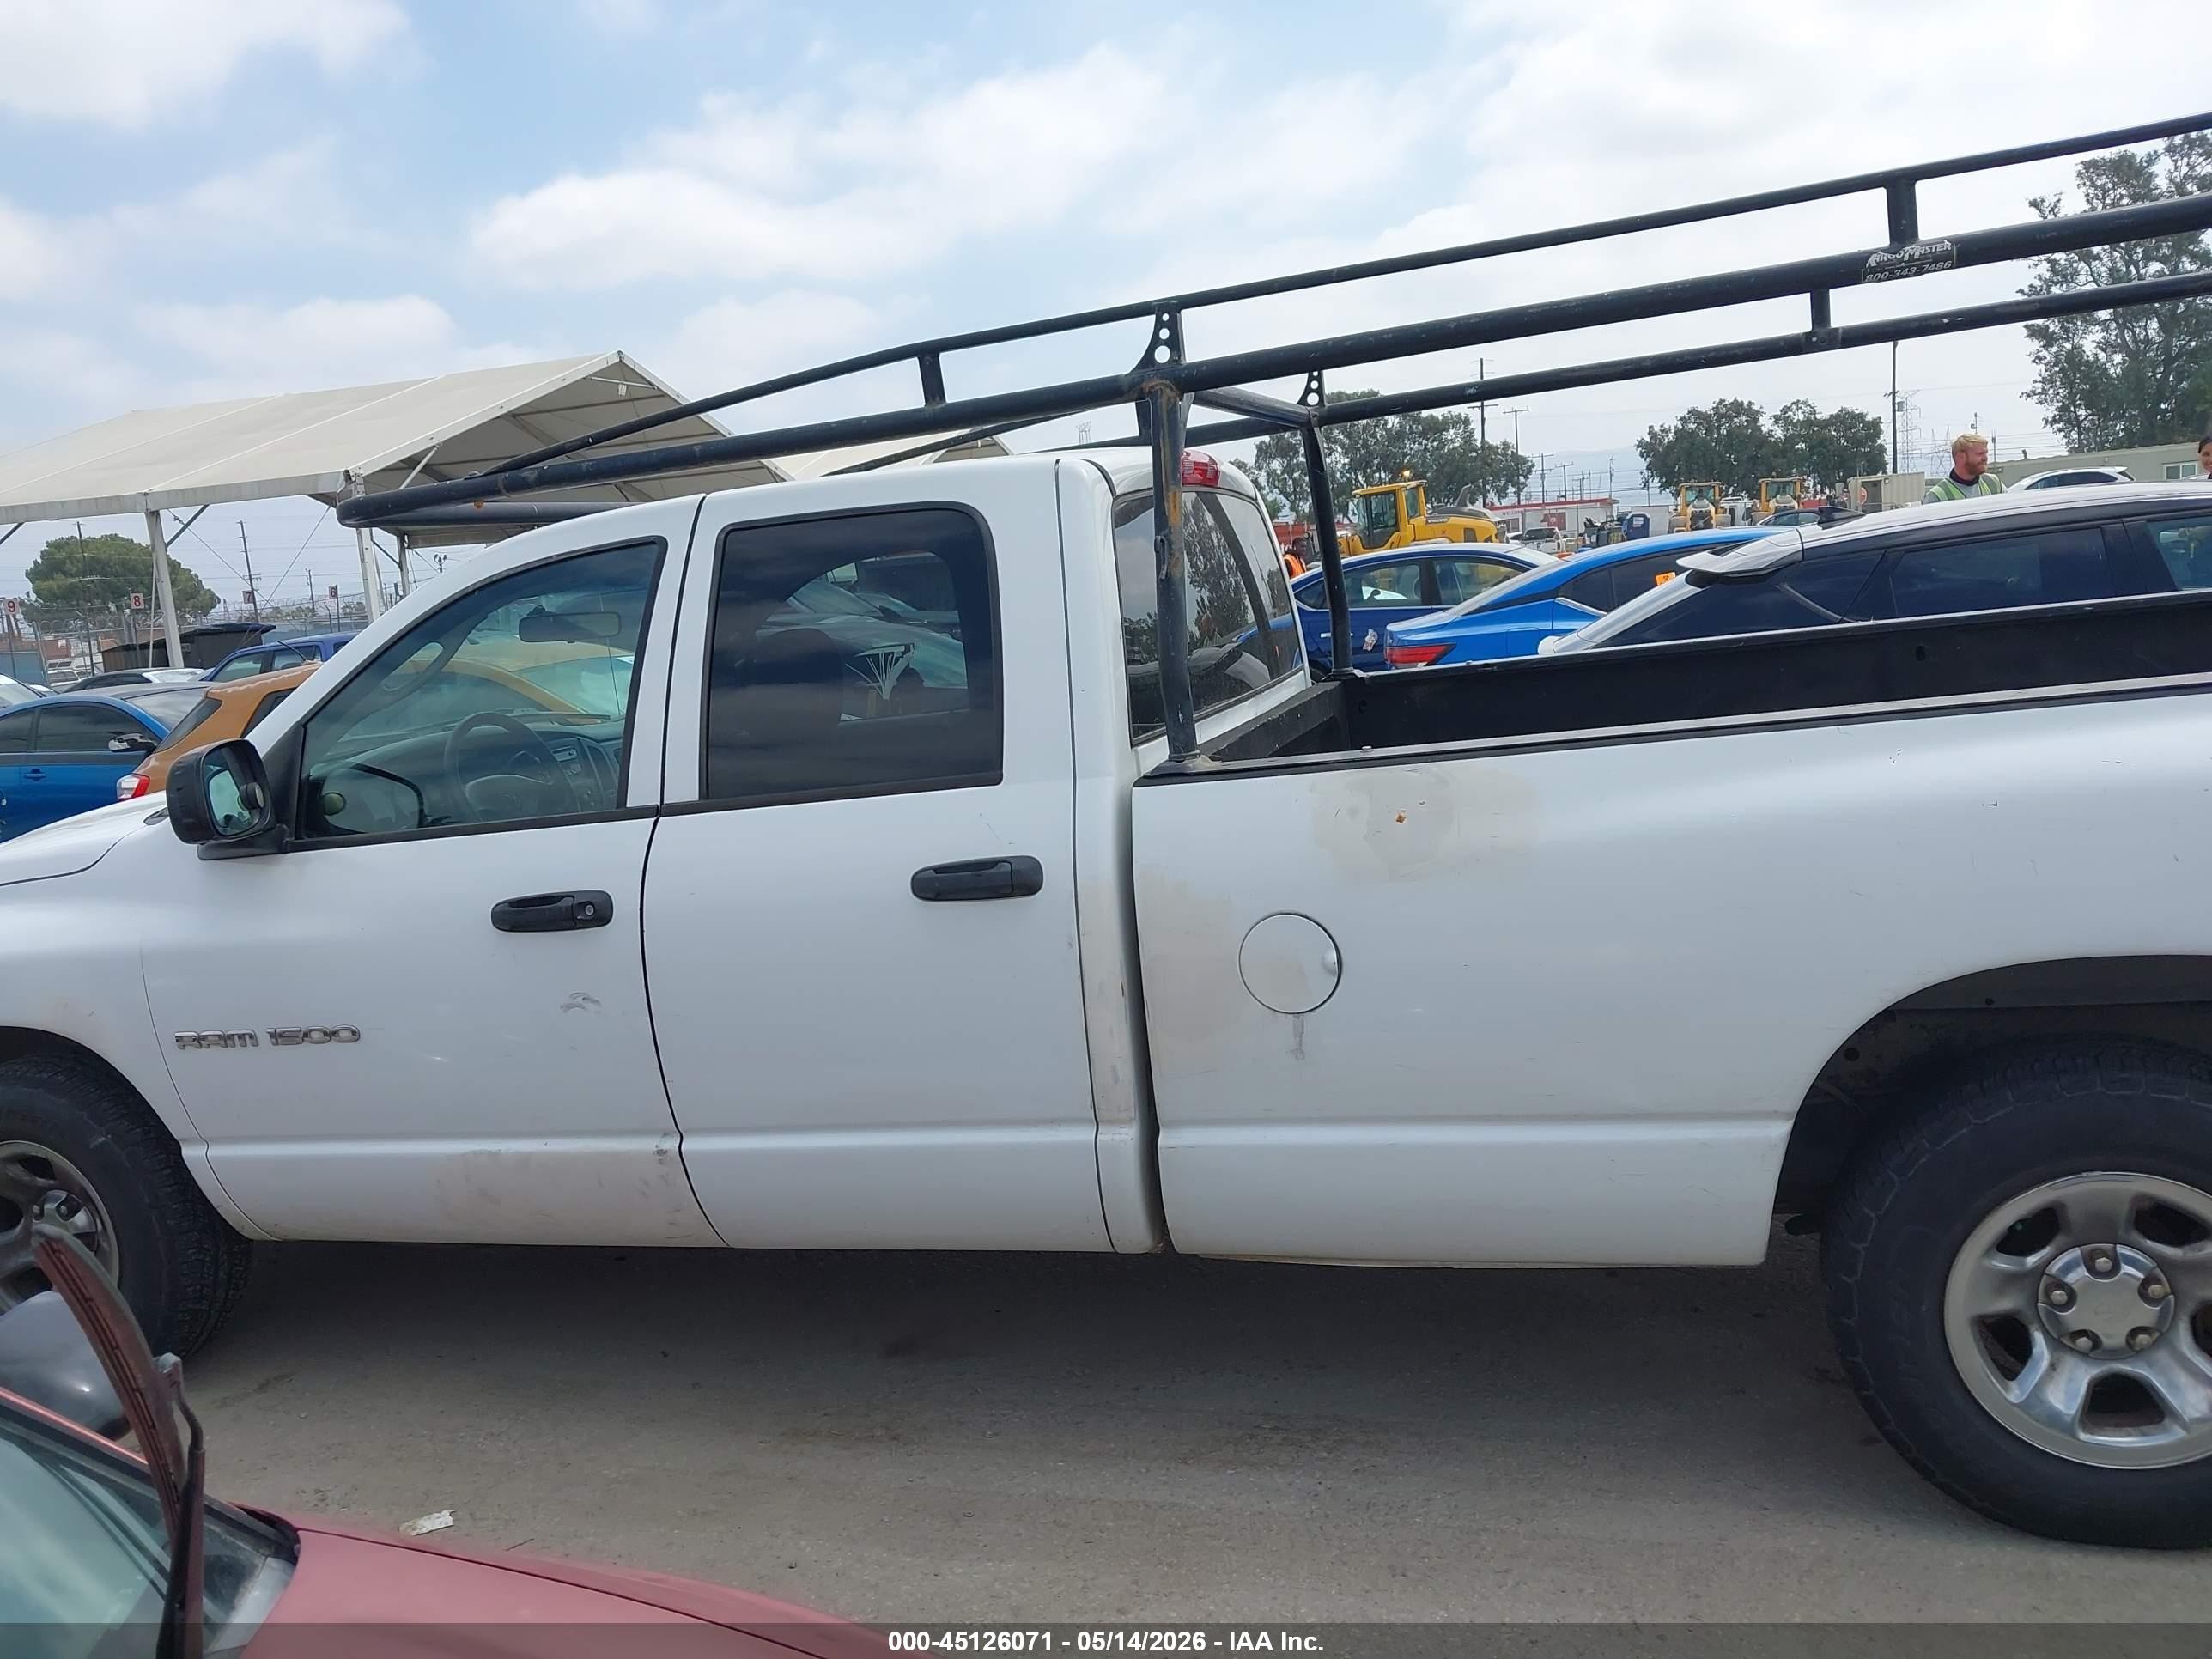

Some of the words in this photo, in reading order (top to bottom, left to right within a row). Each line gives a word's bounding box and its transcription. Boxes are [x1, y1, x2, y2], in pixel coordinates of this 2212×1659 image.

[1865, 260, 1952, 283] 800-343-7486
[7, 600, 15, 612] 9
[133, 595, 141, 606] 8
[266, 1024, 361, 1046] 1500
